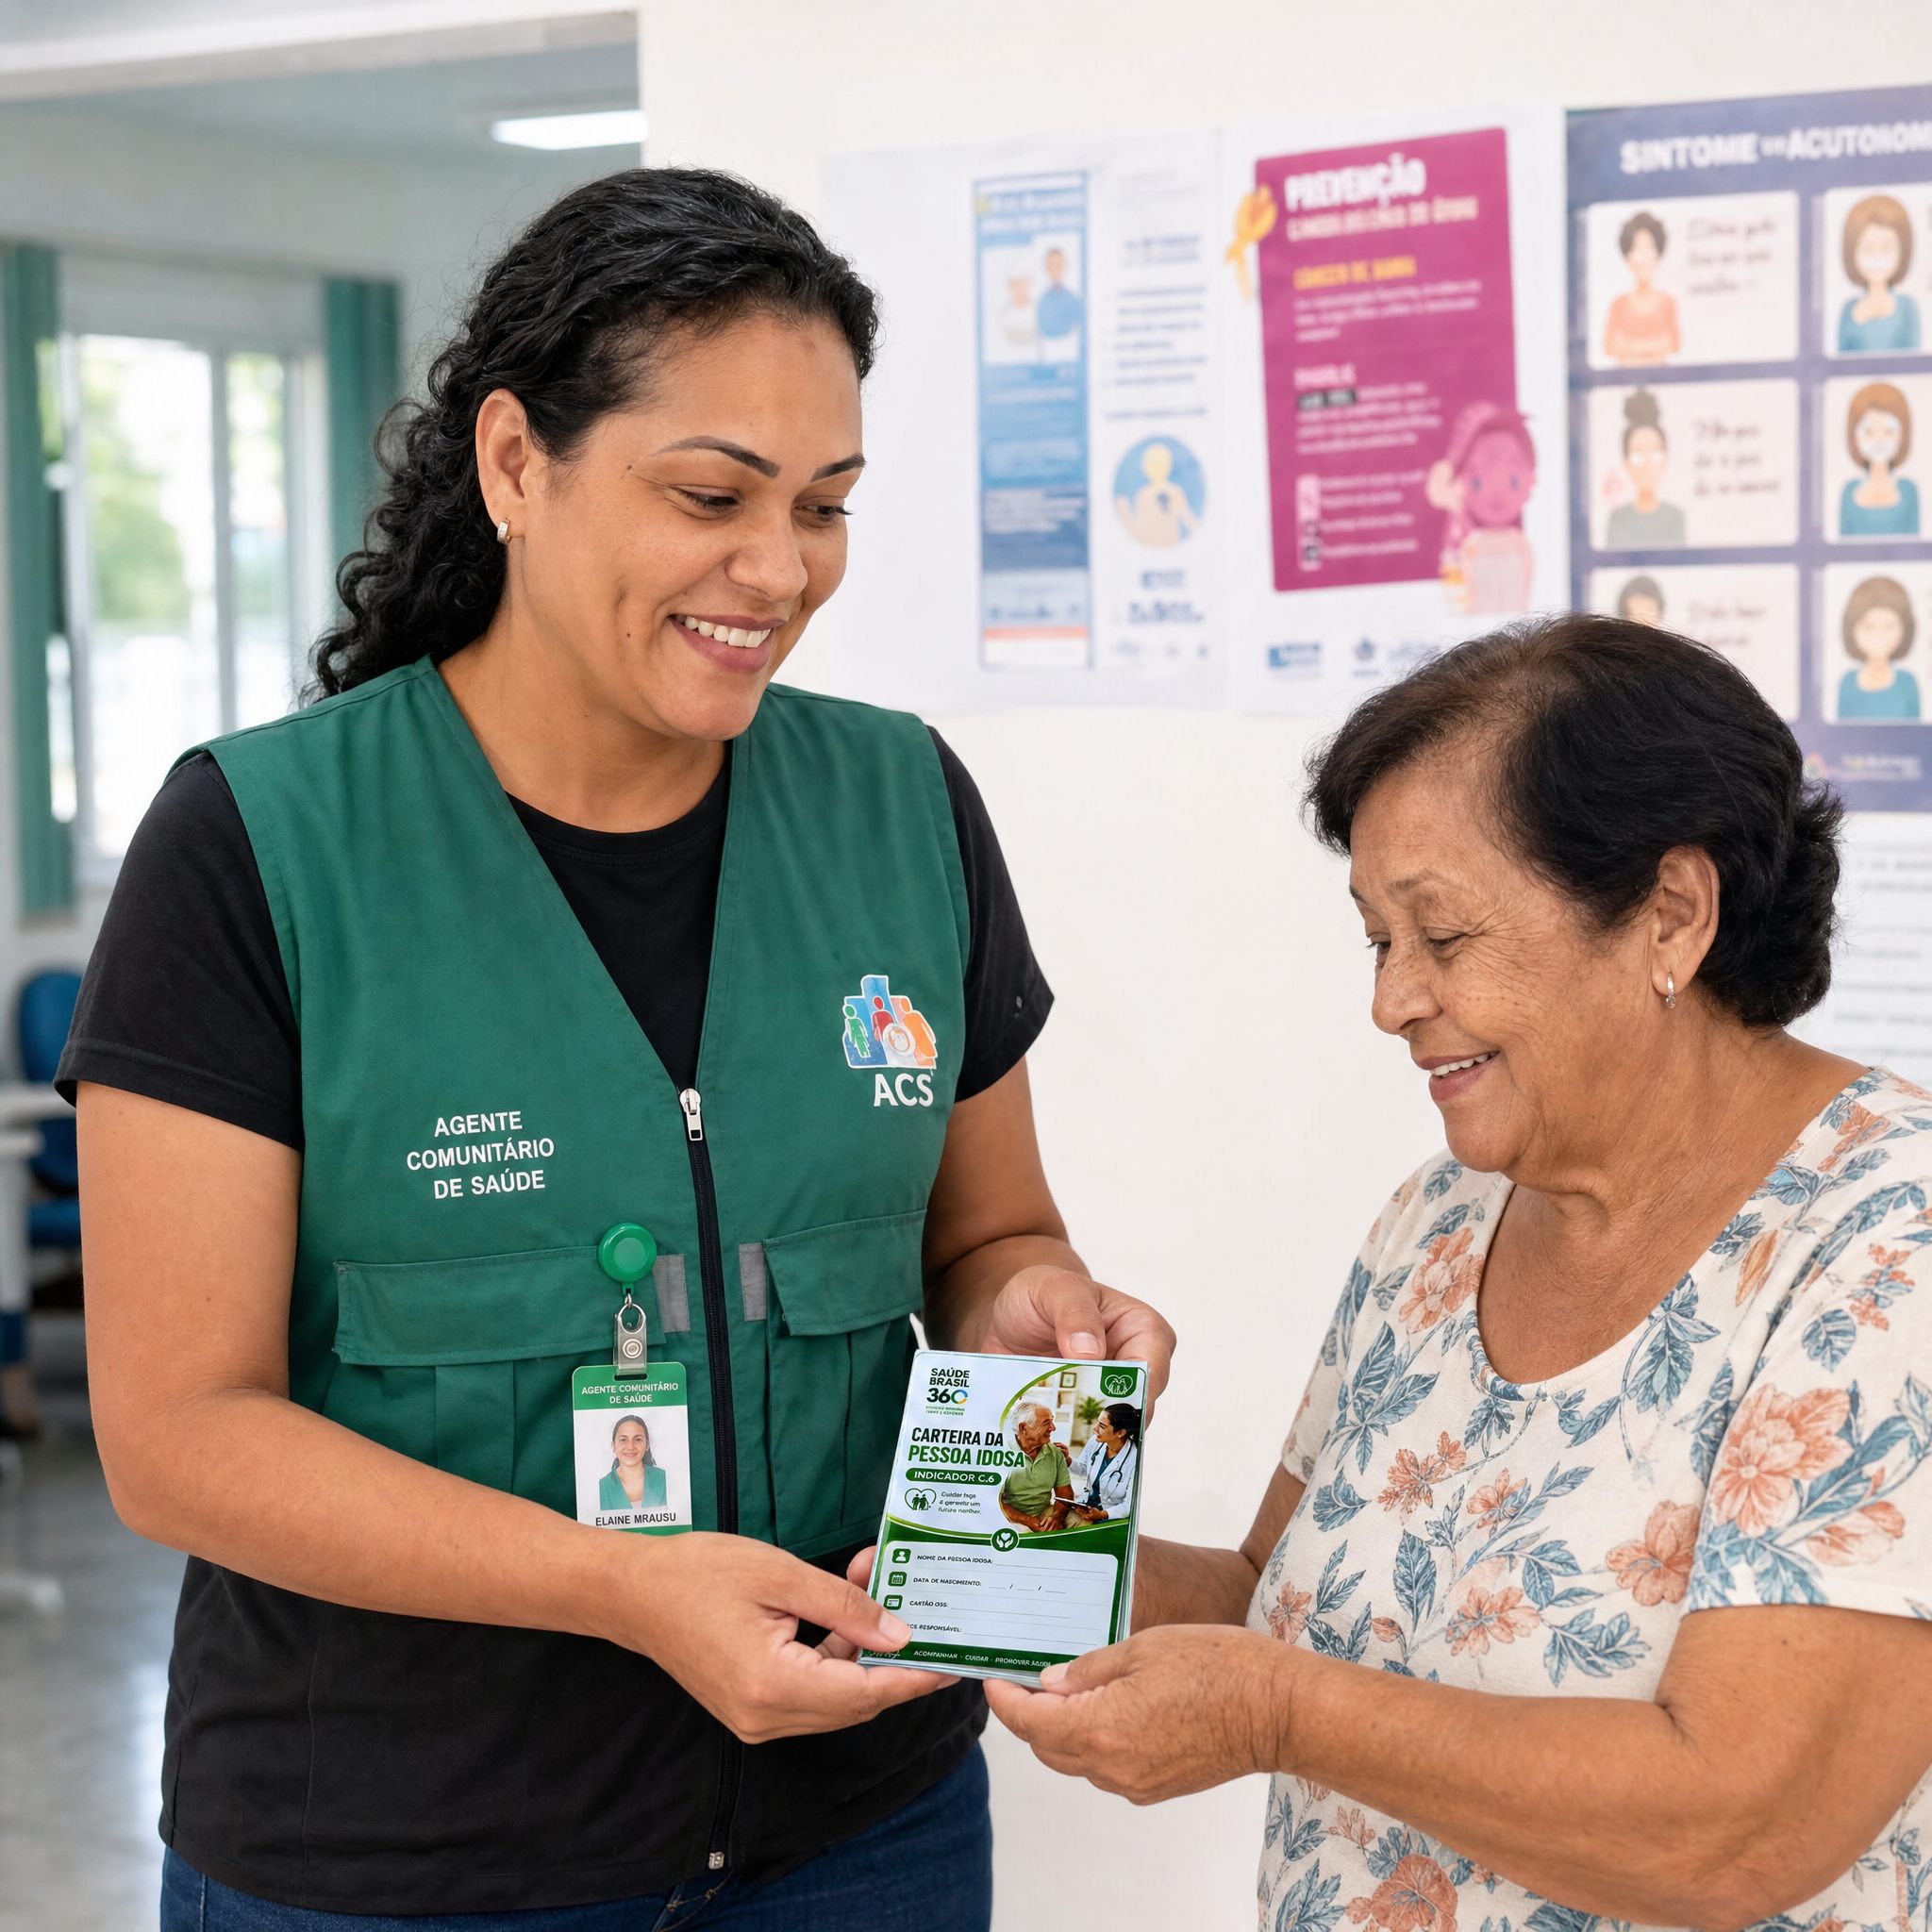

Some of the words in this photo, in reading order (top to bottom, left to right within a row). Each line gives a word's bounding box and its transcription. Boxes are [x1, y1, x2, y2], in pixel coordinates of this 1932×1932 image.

[1284, 152, 1426, 212] PREVENÇÃO
[874, 1073, 934, 1107] ACS
[434, 1110, 523, 1138] AGENTE
[407, 1137, 555, 1171] COMUNITÁRIO
[433, 1178, 463, 1200] DE
[472, 1168, 545, 1195] SAÚDE
[931, 1367, 970, 1378] SAÚDE
[581, 1385, 616, 1395] AGENTE
[619, 1381, 679, 1392] COMUNITÁRIO
[929, 1377, 970, 1388] BRASIL
[624, 1392, 653, 1403] SAÚDE
[926, 1388, 968, 1405] 360
[911, 1427, 981, 1445] CARTEIRA
[984, 1432, 1004, 1446] DA
[908, 1445, 971, 1465] PESSOA
[976, 1449, 1024, 1468] IDOSA
[914, 1472, 975, 1482] INDICADOR
[978, 1474, 995, 1483] C.6
[595, 1515, 631, 1526] ELAINE
[634, 1512, 676, 1524] MRAUSU
